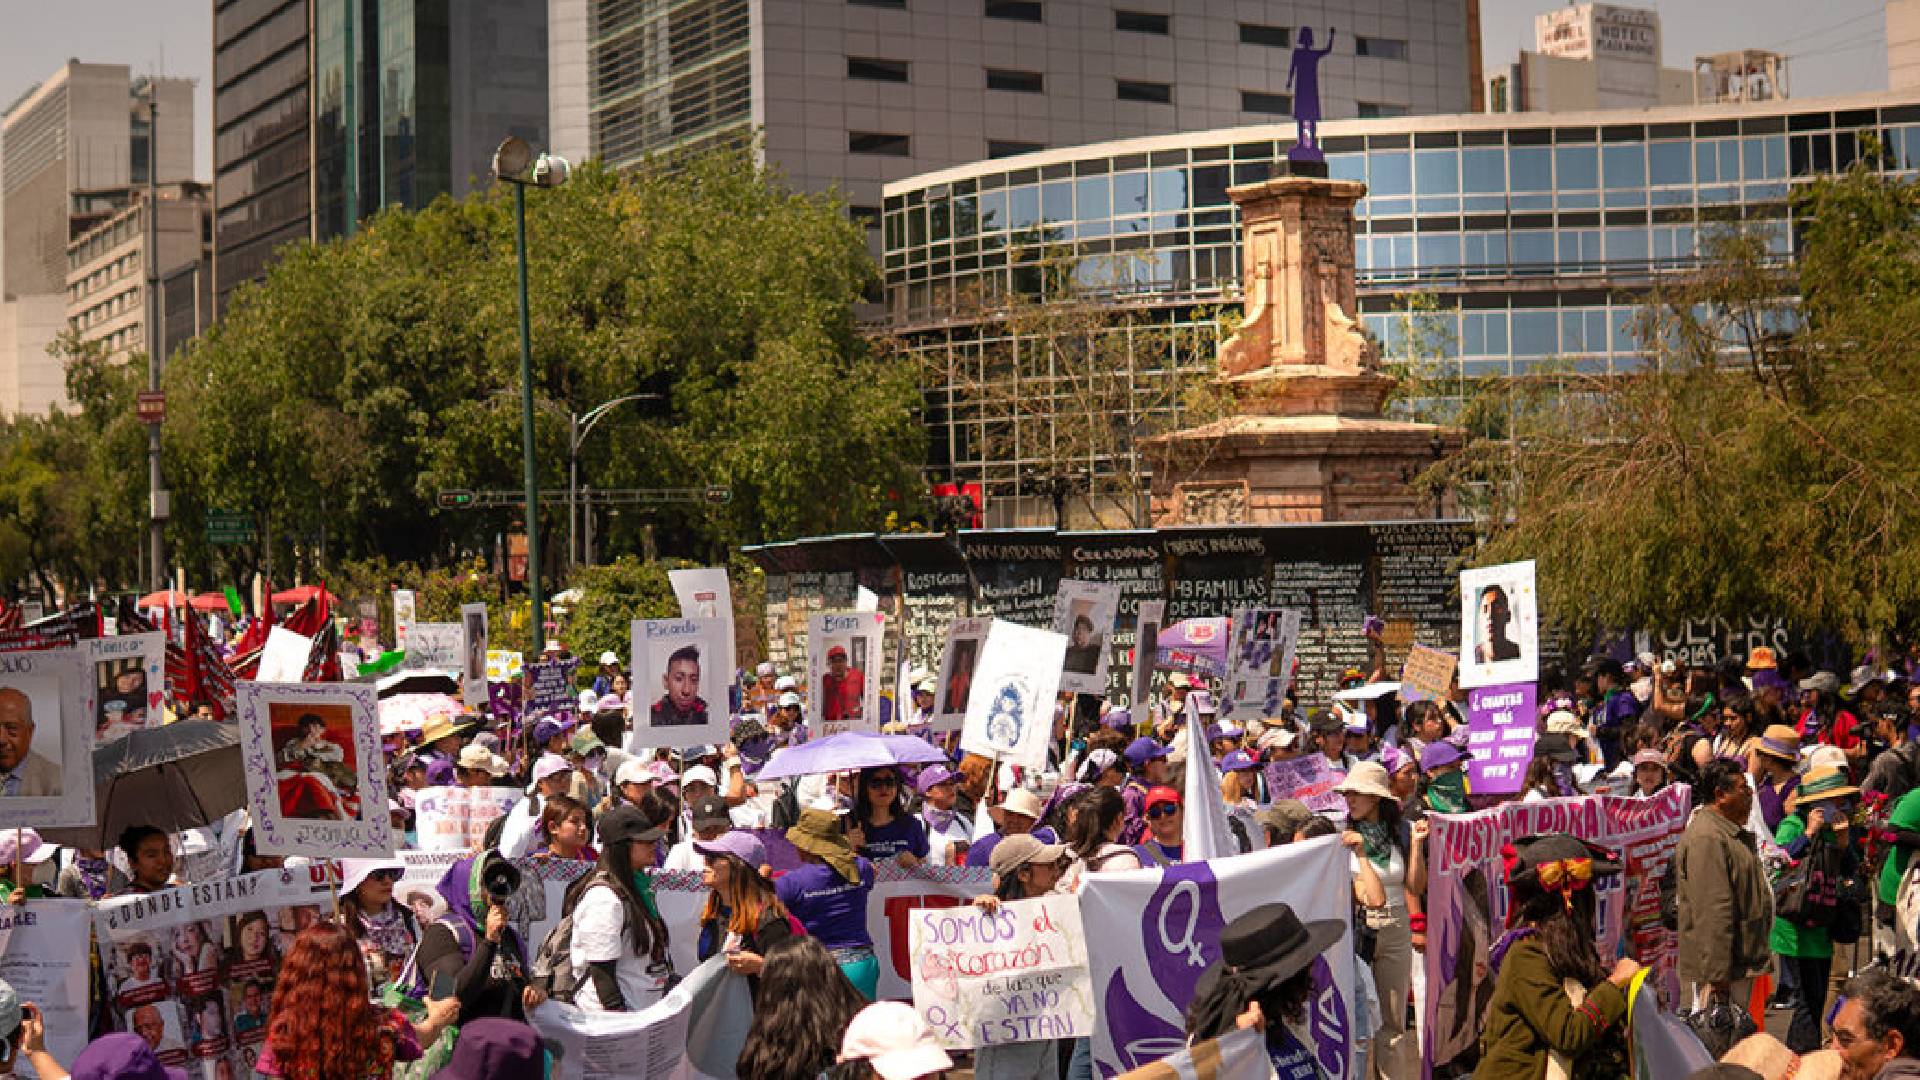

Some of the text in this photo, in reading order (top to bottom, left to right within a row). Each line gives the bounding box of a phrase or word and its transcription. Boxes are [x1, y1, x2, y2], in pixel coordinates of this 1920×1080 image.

[1195, 577, 1265, 598] FAMILIAS
[1535, 797, 1600, 840] PARA
[923, 904, 1058, 945] SOMOS el
[955, 942, 1055, 977] corazón
[982, 973, 1063, 997] de las que
[1001, 989, 1061, 1015] YA NO
